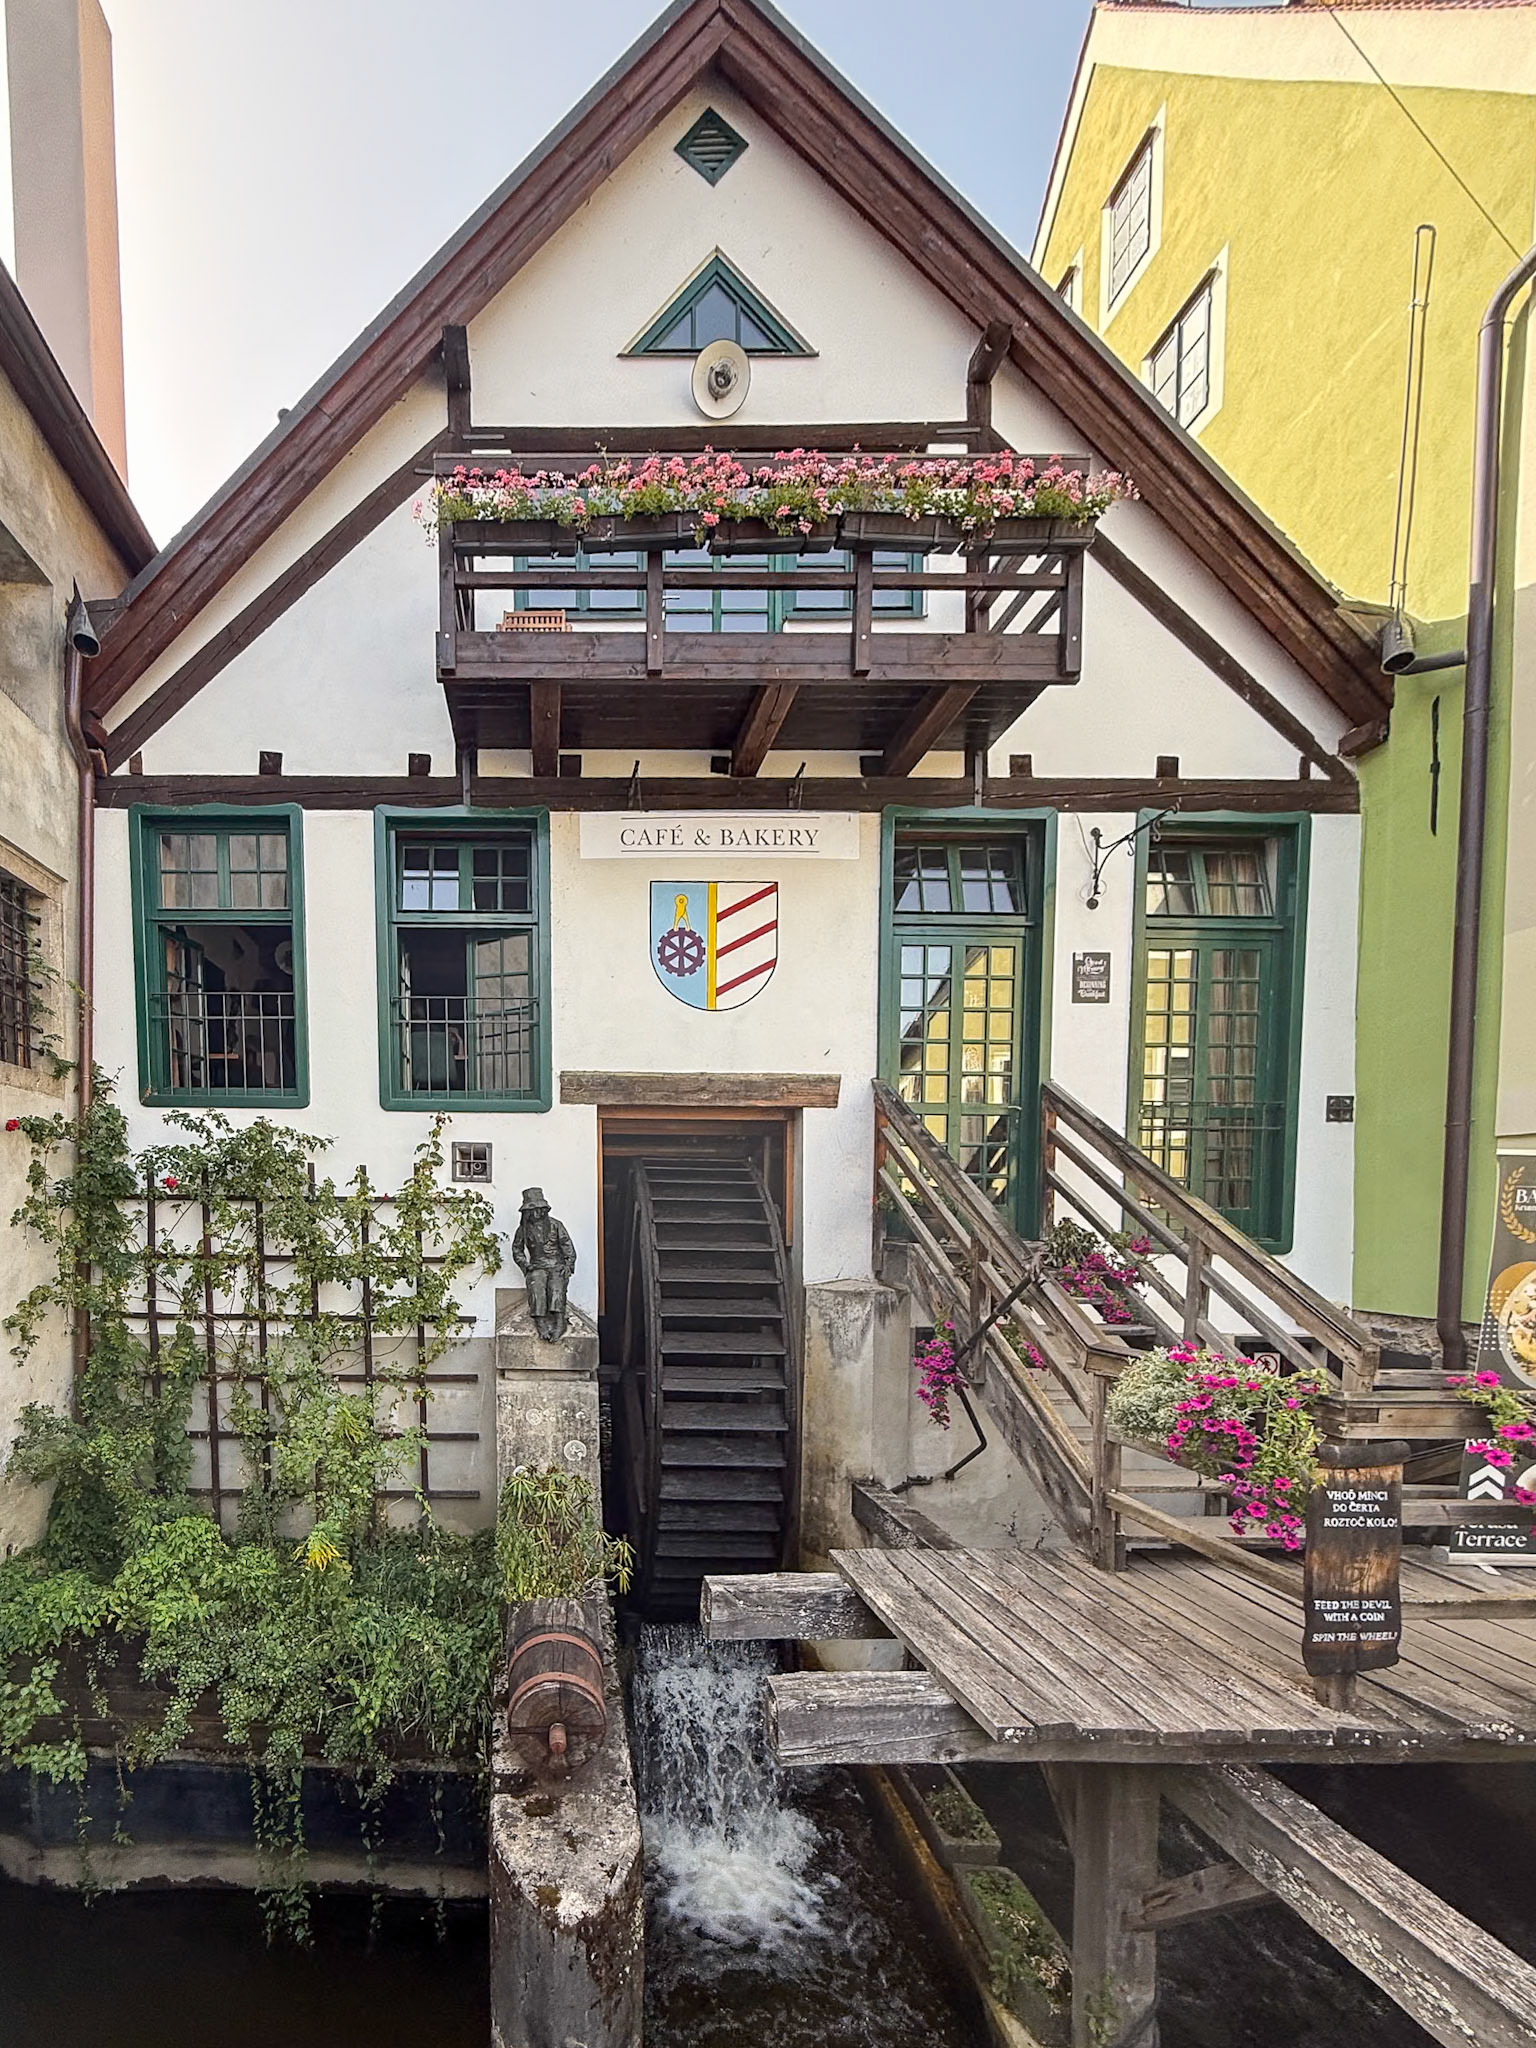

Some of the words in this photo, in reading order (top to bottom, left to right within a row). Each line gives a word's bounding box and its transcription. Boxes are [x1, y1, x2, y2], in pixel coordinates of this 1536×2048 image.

[620, 824, 684, 846] CAFÉ
[694, 830, 711, 846] &
[719, 828, 820, 846] BAKERY
[1326, 1489, 1356, 1500] VHOĎ
[1357, 1490, 1389, 1500] MINCI
[1332, 1503, 1347, 1513] DO
[1348, 1501, 1380, 1513] ČERTA
[1323, 1516, 1365, 1528] ROZTOČ
[1366, 1517, 1398, 1528] KOLO!
[1454, 1530, 1528, 1548] Terrace
[1313, 1600, 1340, 1610] FEED
[1340, 1600, 1360, 1610] THE
[1361, 1600, 1393, 1610] DEVIL
[1323, 1612, 1350, 1622] WITH
[1350, 1612, 1358, 1622] A
[1359, 1612, 1385, 1621] COIN
[1311, 1632, 1336, 1643] SPIN
[1336, 1632, 1357, 1642] THE
[1359, 1631, 1398, 1641] WHEEL!
